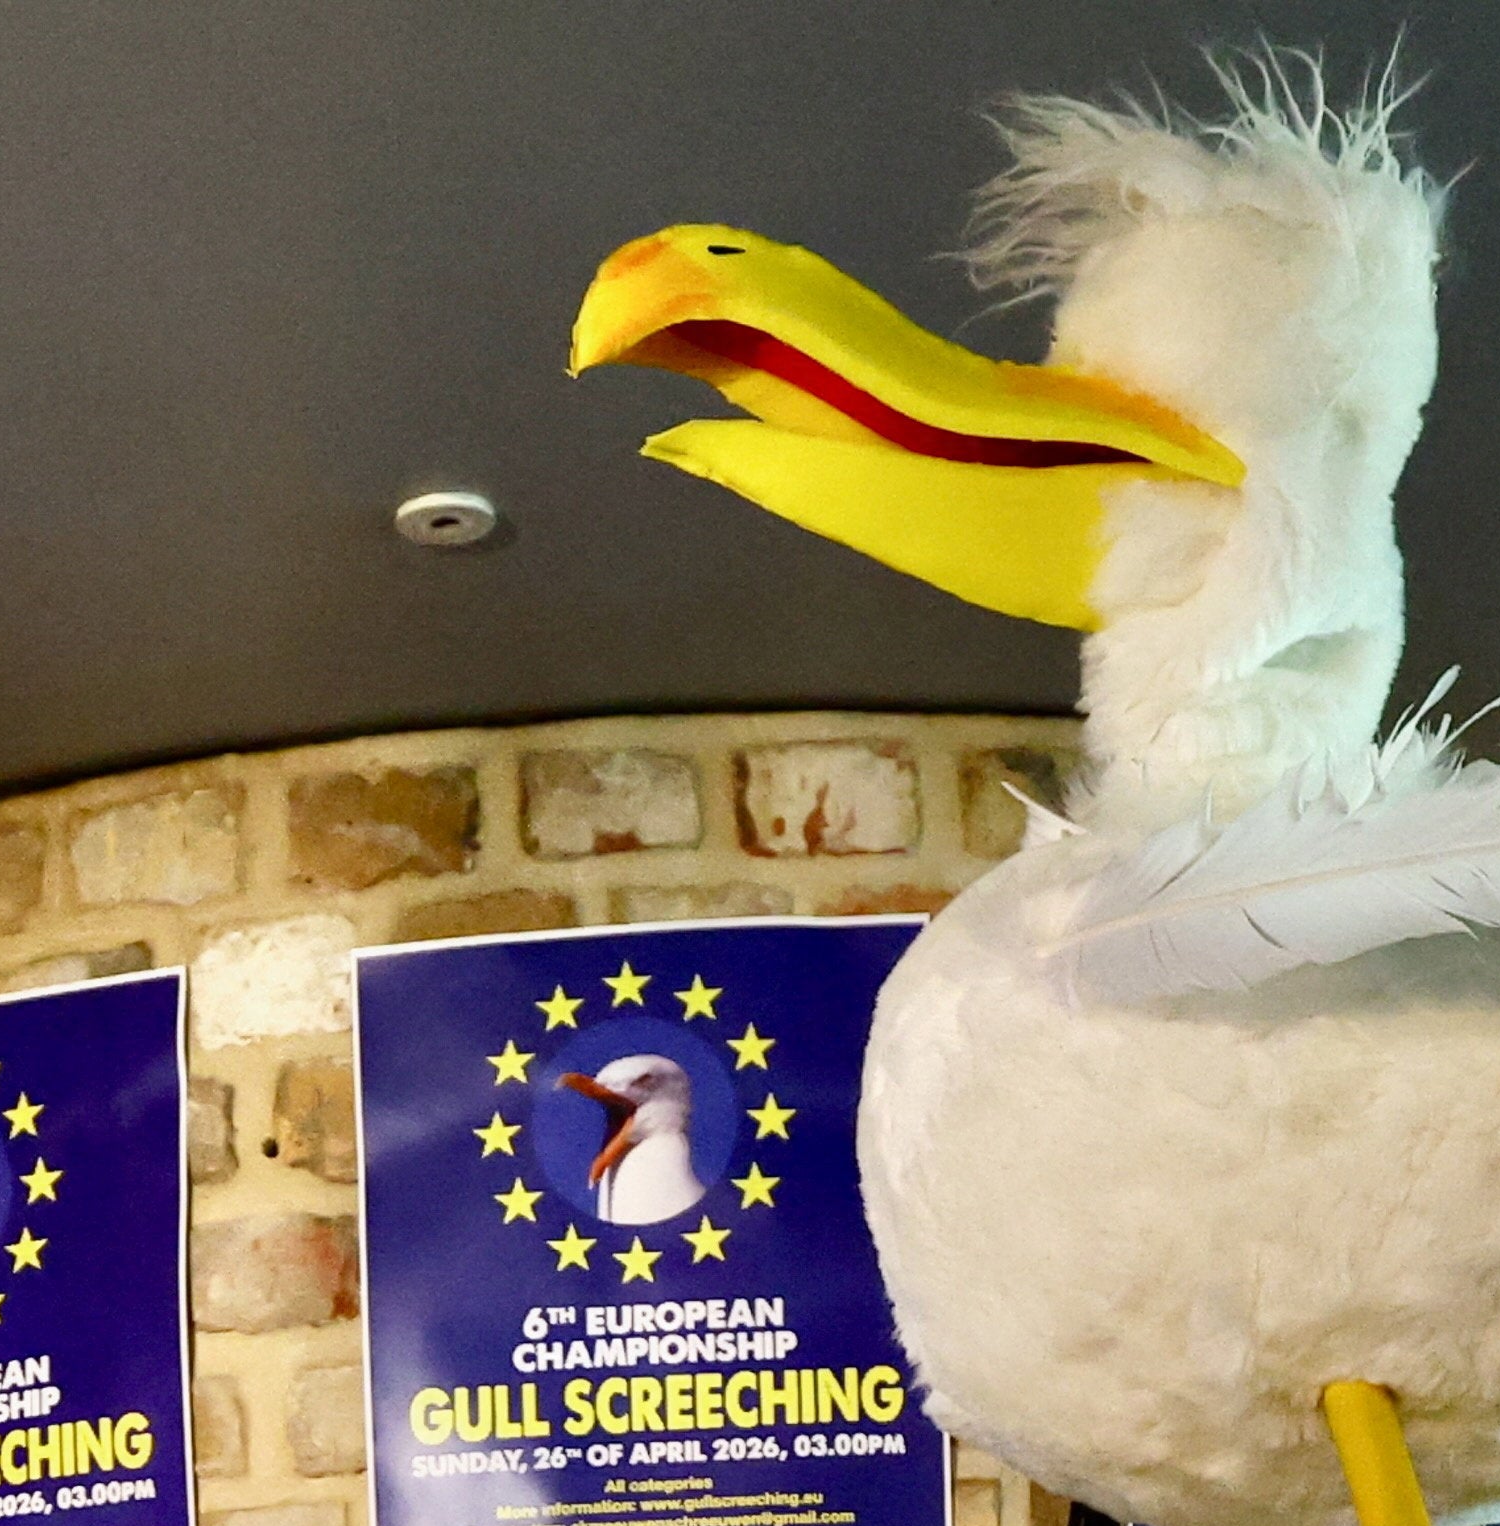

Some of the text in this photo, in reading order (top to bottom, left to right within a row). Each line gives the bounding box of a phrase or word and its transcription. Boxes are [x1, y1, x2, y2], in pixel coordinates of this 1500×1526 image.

[522, 1297, 784, 1340] 6TH EUROPEAN
[512, 1330, 797, 1373] CHAMPIONSHIP
[409, 1364, 904, 1446] GULL SCREECHING
[412, 1448, 528, 1479] SUNDAY,
[587, 1443, 624, 1466] OF
[629, 1439, 707, 1465] APRIL
[713, 1437, 788, 1463] 2026,
[794, 1433, 906, 1457] 03.00PM
[57, 1479, 156, 1509] 03.00PM
[605, 1477, 713, 1494] All categories
